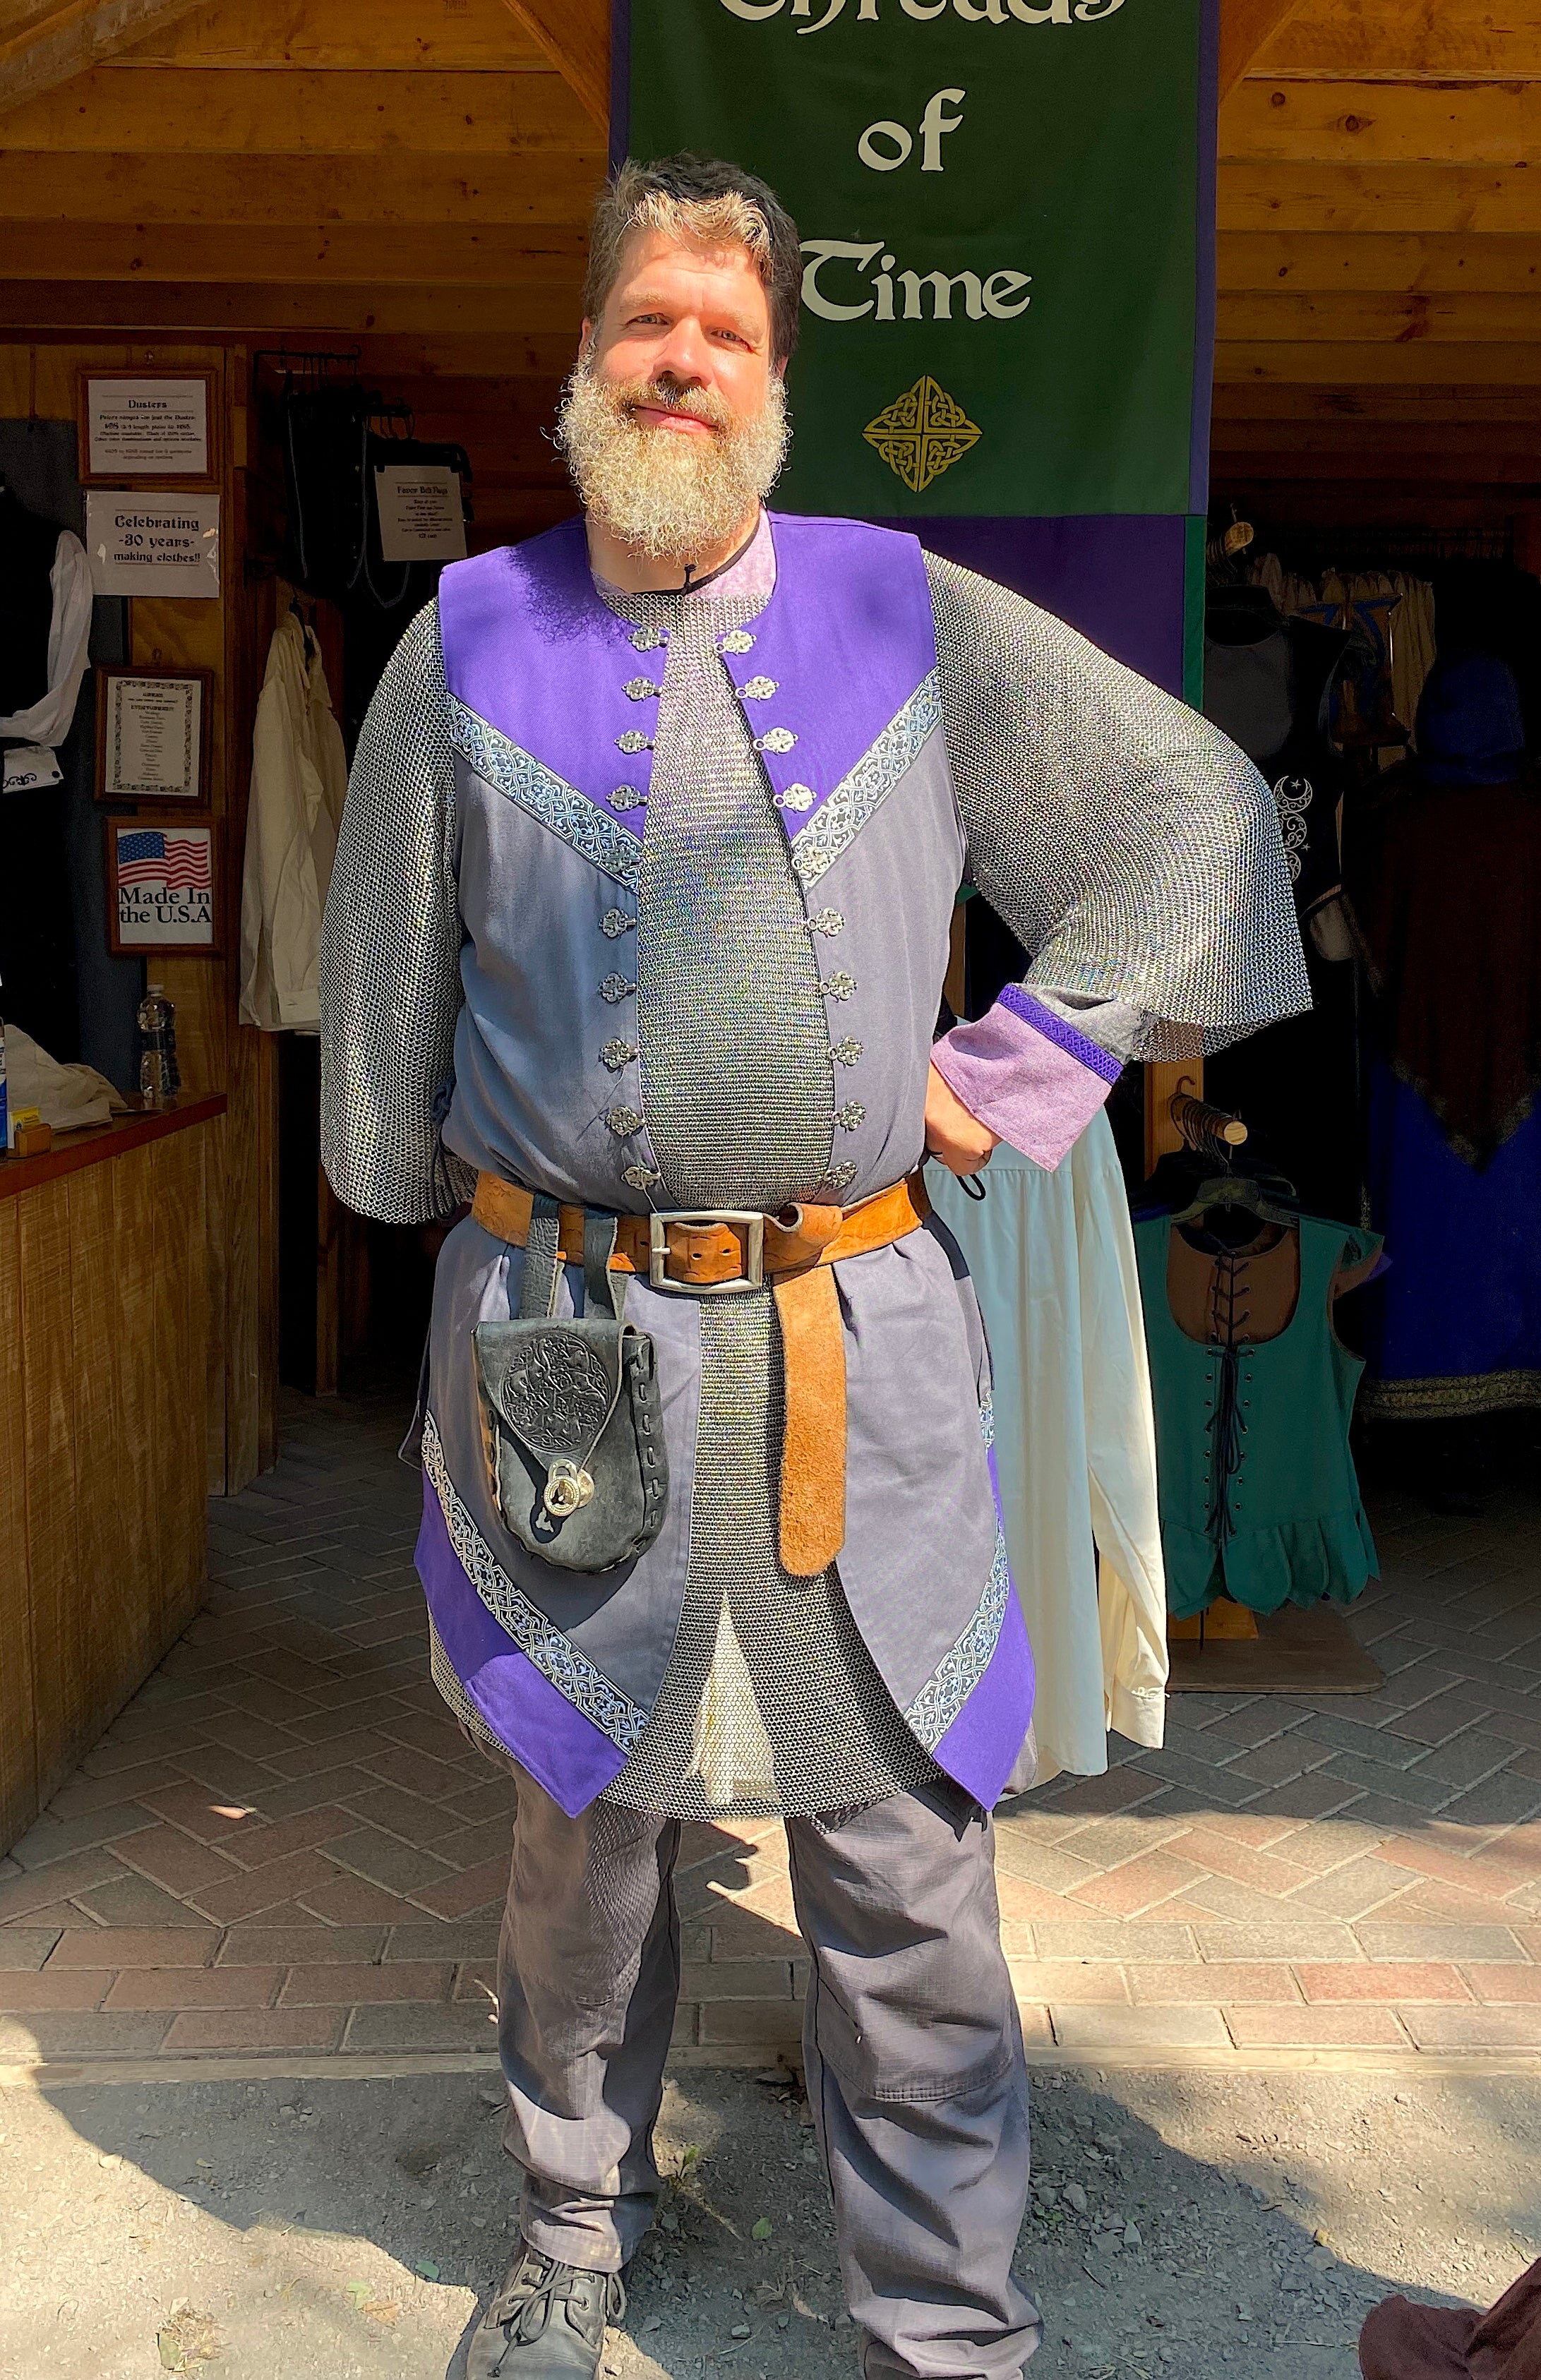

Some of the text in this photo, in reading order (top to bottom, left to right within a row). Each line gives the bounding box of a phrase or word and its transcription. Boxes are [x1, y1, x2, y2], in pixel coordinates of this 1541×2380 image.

[858, 88, 966, 172] of
[798, 239, 1033, 321] Time
[128, 399, 167, 409] Dusters
[114, 515, 199, 531] Celebrating
[119, 534, 143, 546] -30
[114, 551, 200, 563] making clothes!!
[119, 887, 211, 904] Made In
[119, 906, 212, 923] the U.S.A
